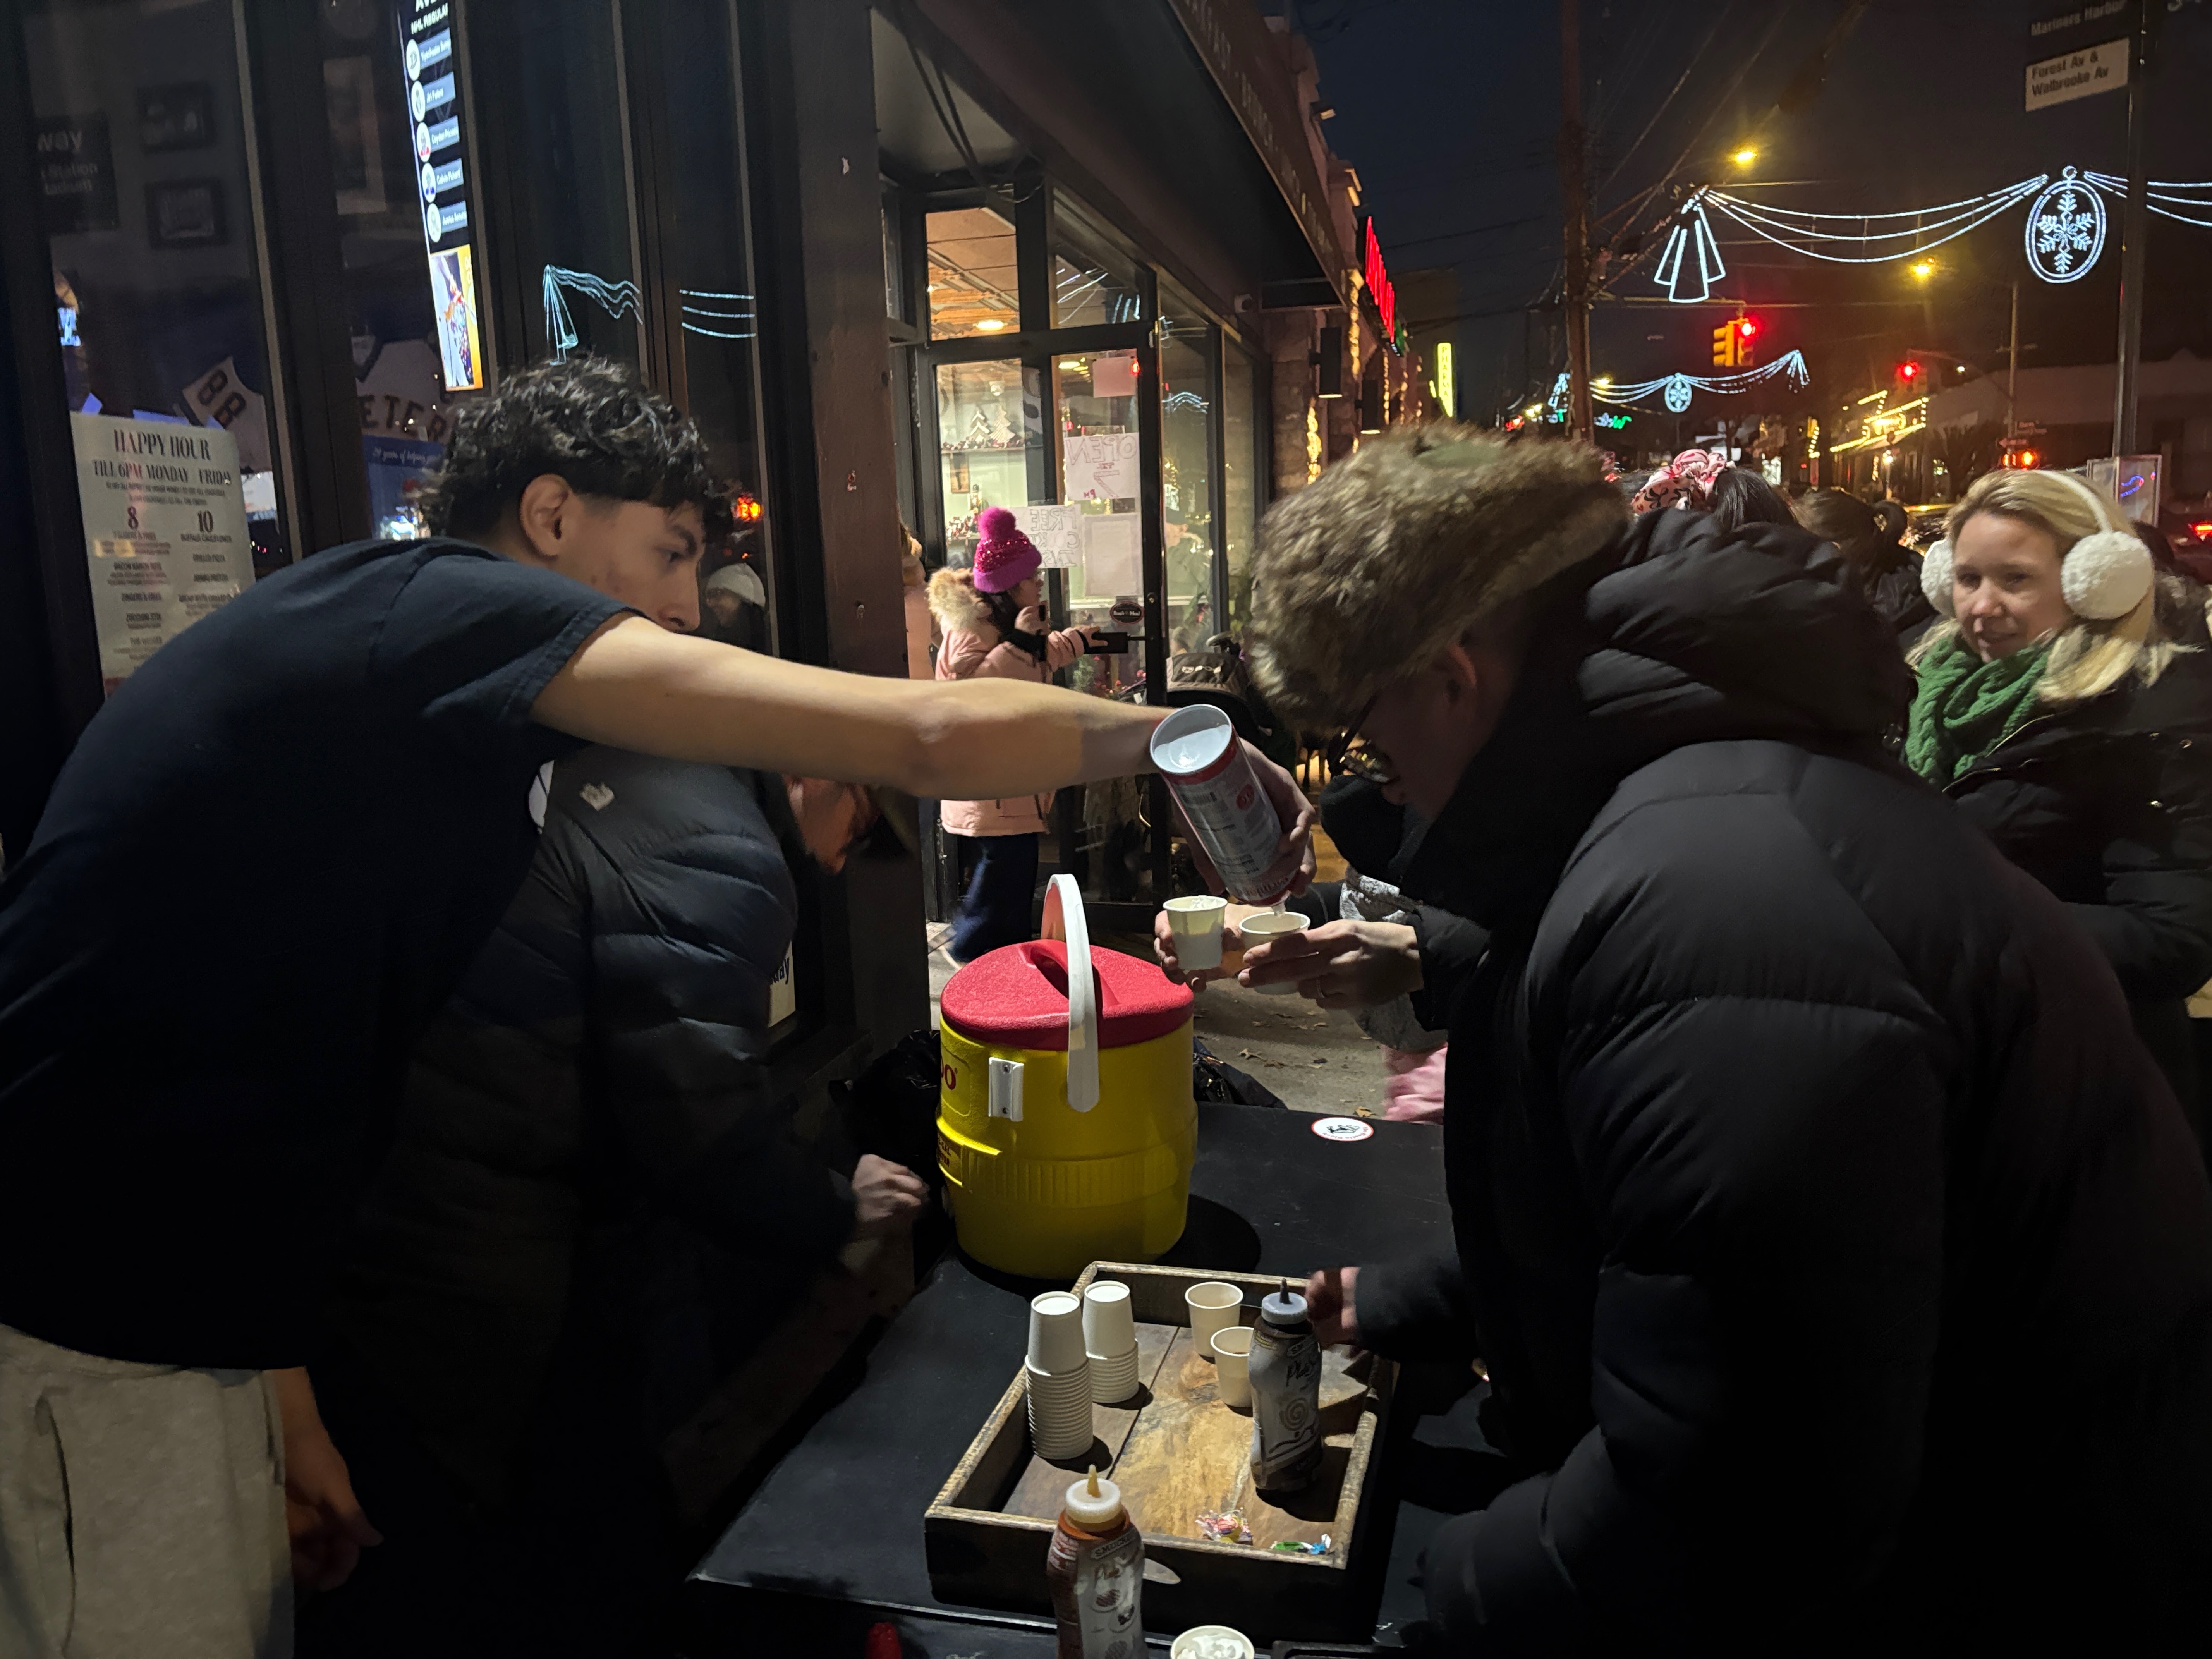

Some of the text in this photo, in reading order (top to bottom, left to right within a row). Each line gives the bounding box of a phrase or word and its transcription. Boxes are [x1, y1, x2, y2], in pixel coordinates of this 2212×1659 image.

[2032, 51, 2099, 80] Forest Av &
[2032, 66, 2109, 96] Walbrooke Av
[114, 429, 211, 460] HAPPY HOUR
[146, 465, 189, 483] MONDAY
[199, 469, 232, 485] FRIDAY
[127, 506, 139, 530] 8
[198, 510, 214, 533] 10
